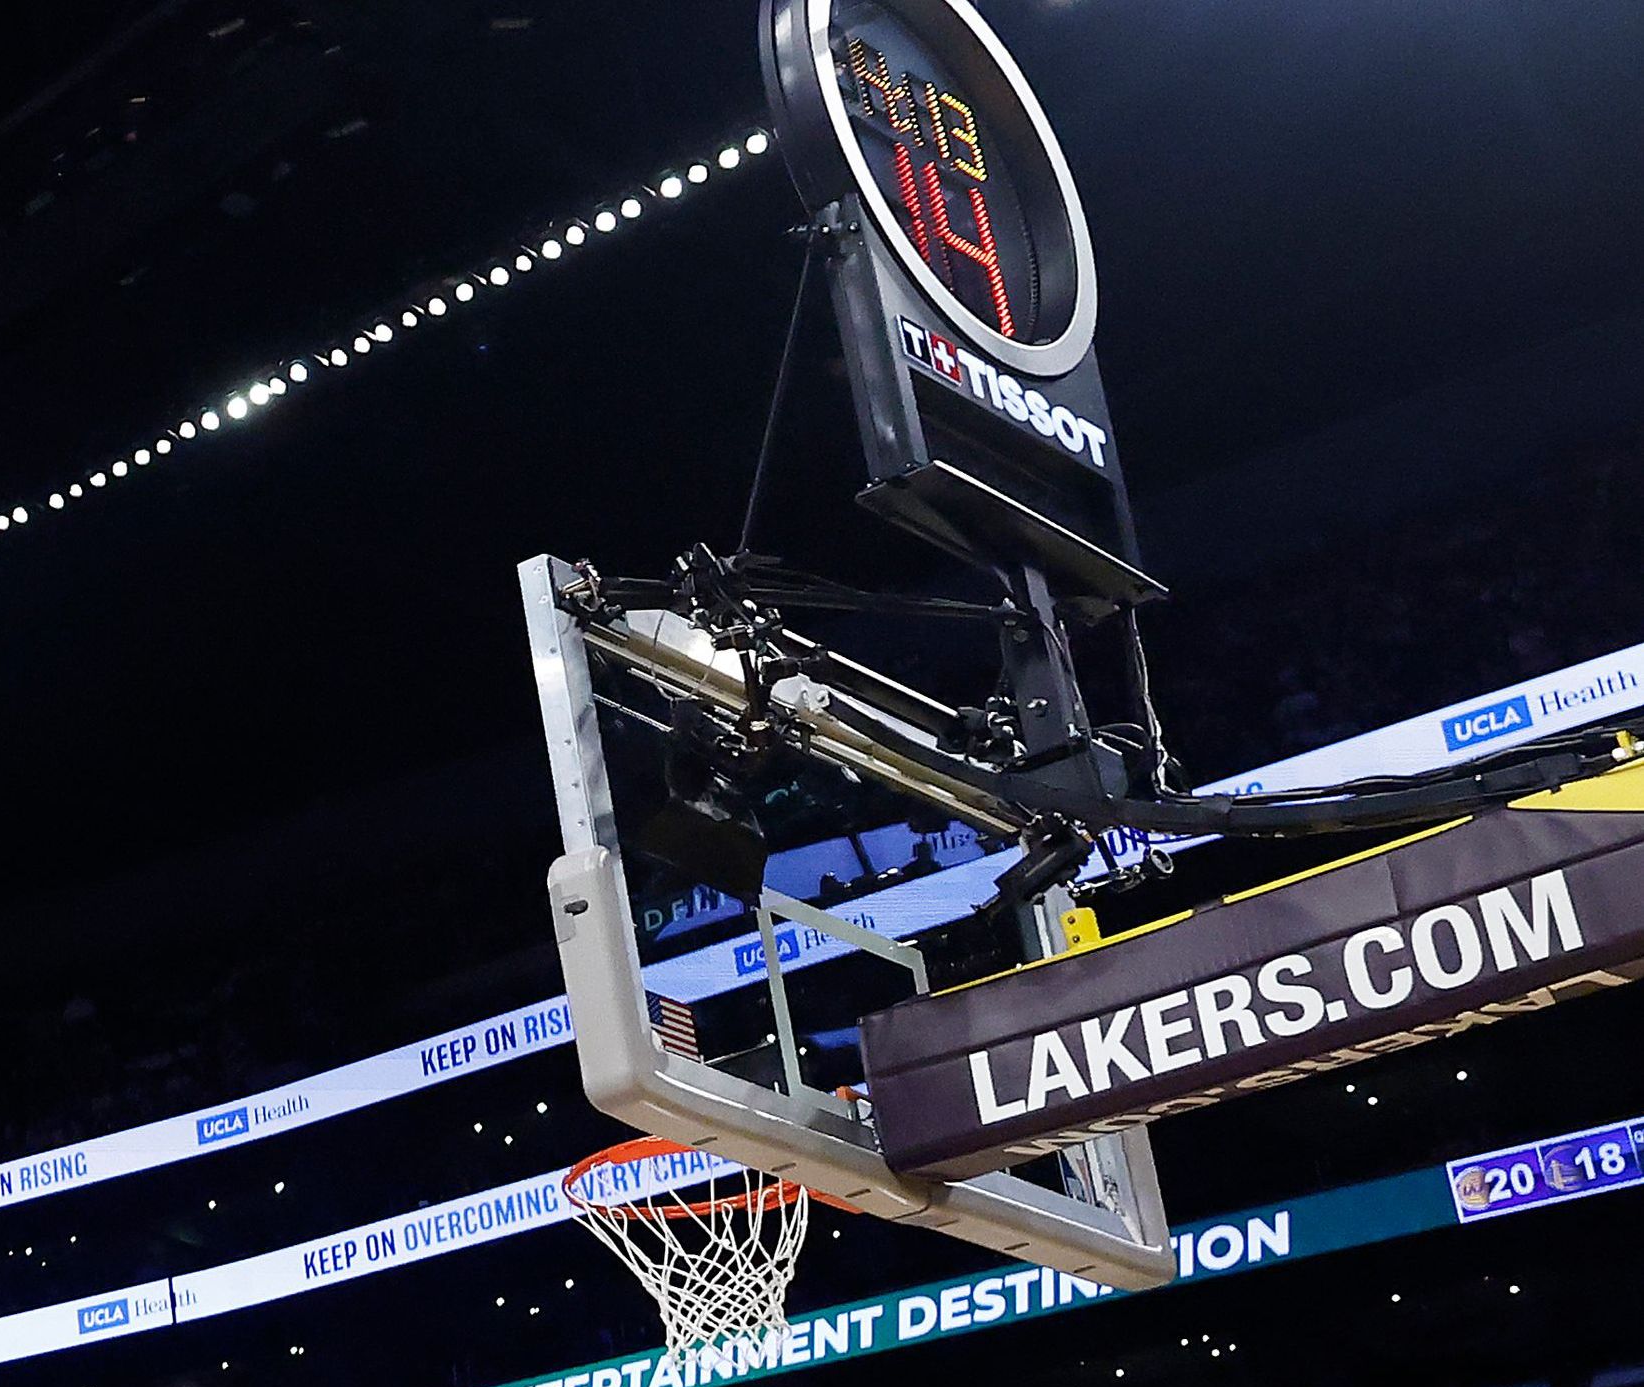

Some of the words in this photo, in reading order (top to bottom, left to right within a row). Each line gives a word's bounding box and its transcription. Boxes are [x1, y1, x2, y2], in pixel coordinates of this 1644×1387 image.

[957, 348, 1107, 468] TISSOT
[1455, 704, 1524, 742] UCLA
[1537, 668, 1638, 718] Health
[967, 869, 1585, 1126] LAKERS.COM
[420, 1034, 475, 1076] KEEP
[485, 1027, 517, 1056] ON
[524, 1005, 572, 1044] RISI
[202, 1114, 244, 1139] UCLA
[253, 1095, 310, 1126] Health
[20, 1152, 88, 1191] RISING
[1484, 1163, 1535, 1203] 20
[1574, 1142, 1626, 1181] 18
[303, 1241, 358, 1280] KEEP
[365, 1230, 397, 1262] ON
[403, 1183, 559, 1252] OVERCOMING
[83, 1305, 125, 1328] UCLA
